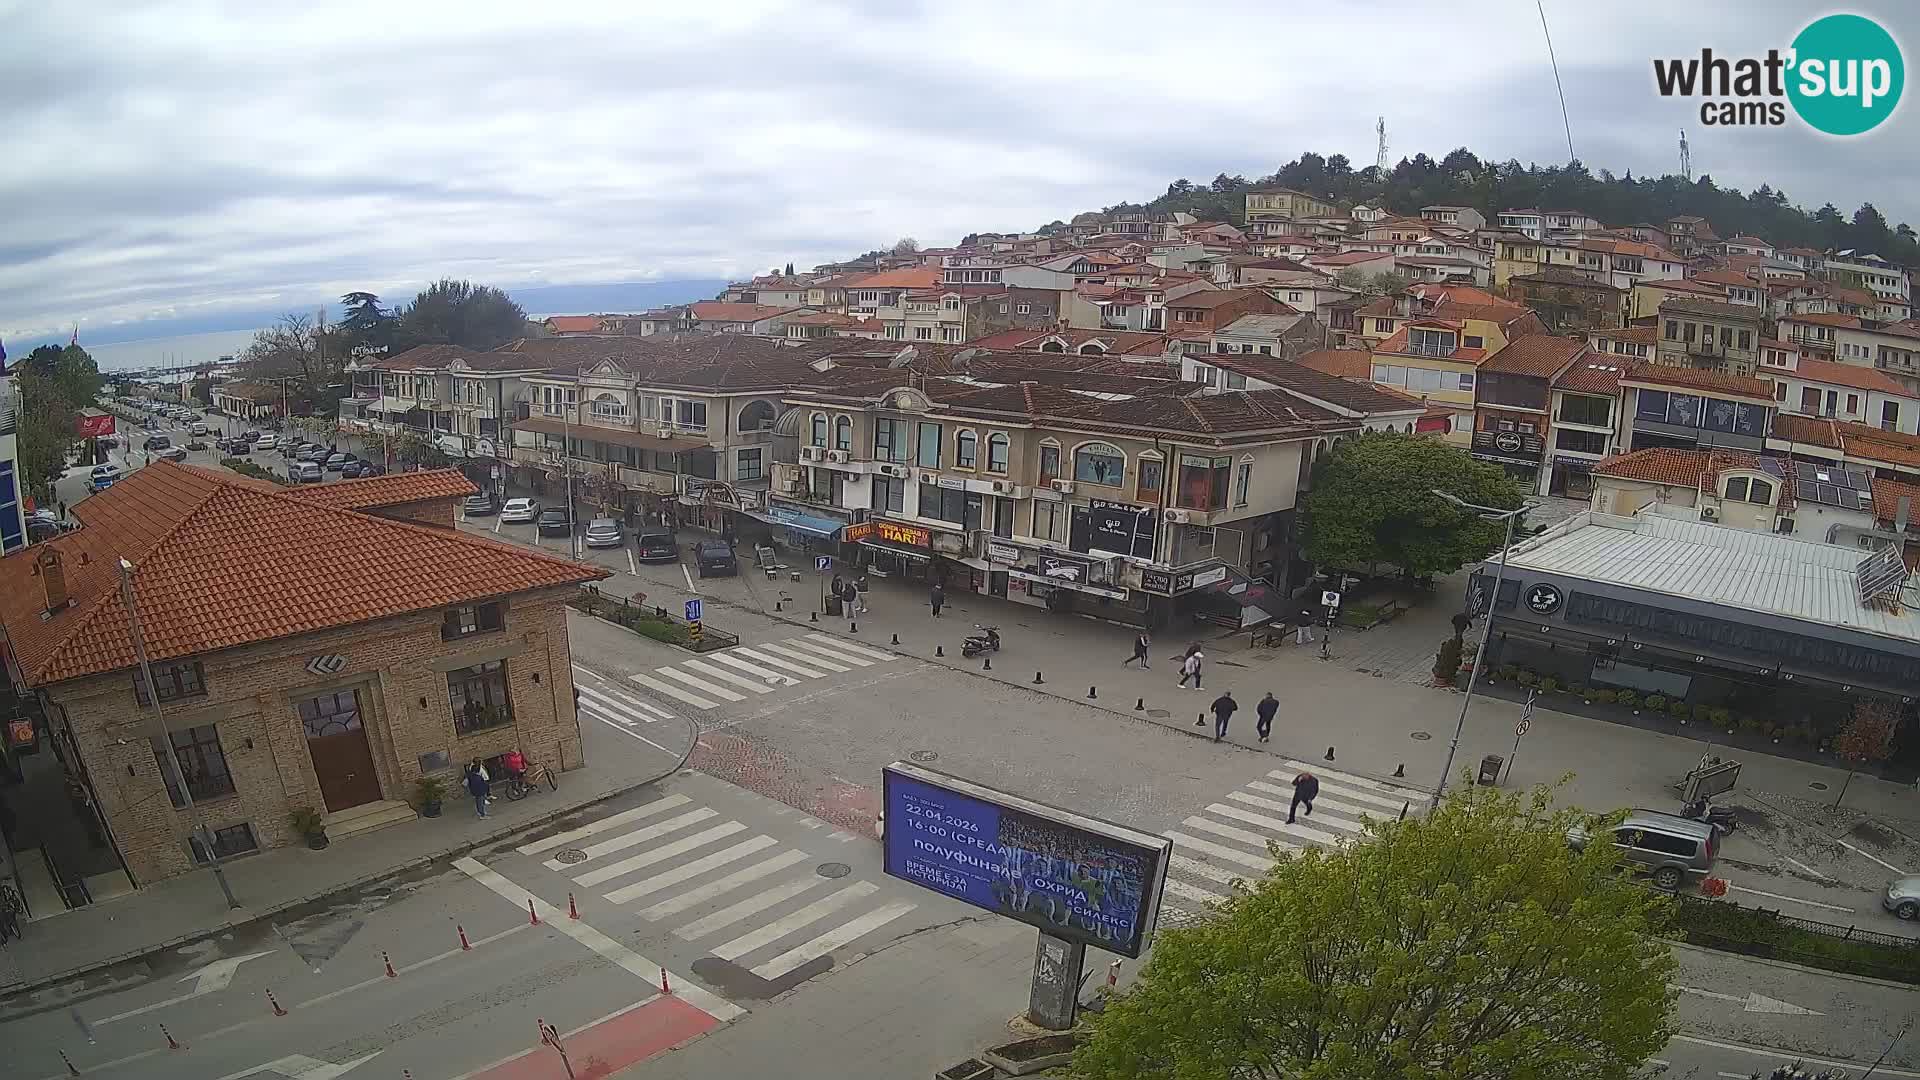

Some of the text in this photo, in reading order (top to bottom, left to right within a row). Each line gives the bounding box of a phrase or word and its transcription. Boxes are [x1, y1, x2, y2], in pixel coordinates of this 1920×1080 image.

[851, 526, 871, 538] HARI
[885, 529, 916, 544] HARI
[820, 558, 827, 568] P
[906, 803, 979, 832] 22.04.2026
[907, 819, 947, 837] 16:00
[914, 839, 1021, 880] полуфинале
[906, 860, 942, 877] ВРЕМЕ
[954, 876, 967, 886] ЗА
[1035, 878, 1087, 902] ОХРИД
[1074, 906, 1129, 927] СИЛЕКС
